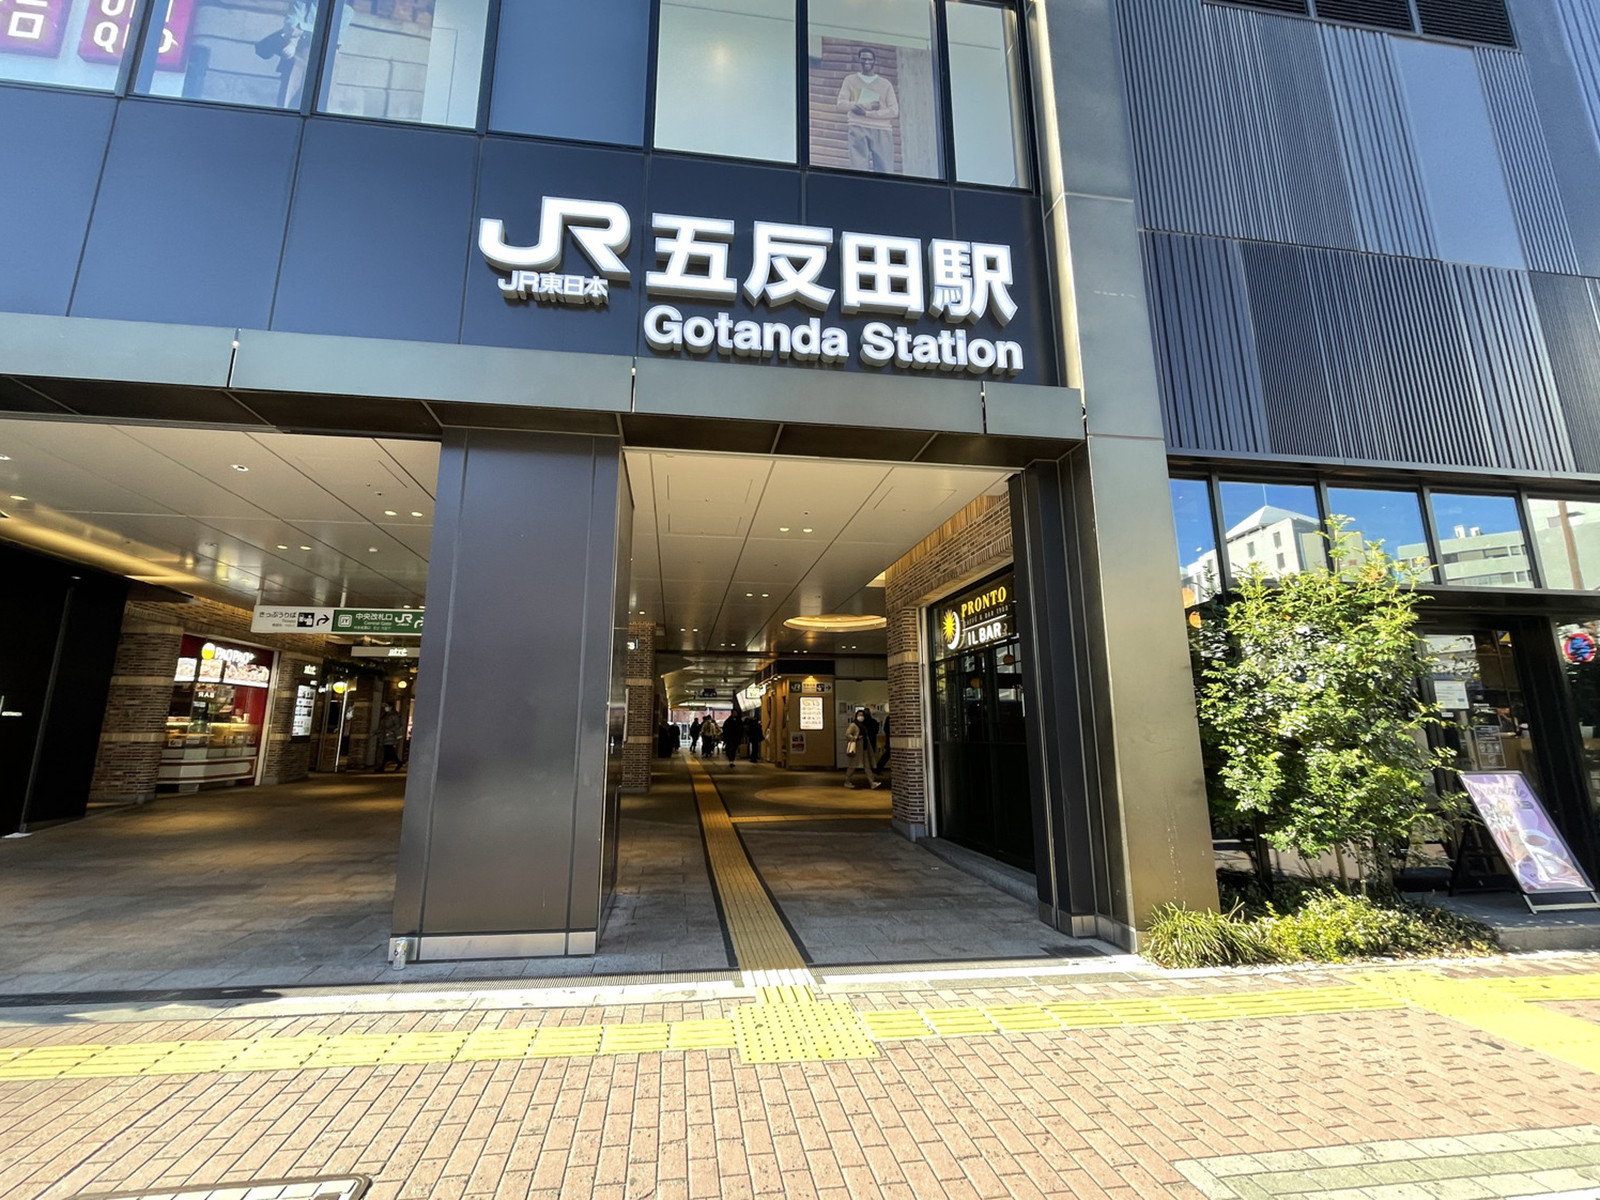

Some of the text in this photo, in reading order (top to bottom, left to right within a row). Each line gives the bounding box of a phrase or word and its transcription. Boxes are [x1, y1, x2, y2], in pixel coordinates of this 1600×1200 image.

[478, 196, 632, 277] JR
[644, 212, 1019, 325] 五反田駅
[497, 269, 610, 303] JR東日本
[643, 304, 1024, 375] Gotanda Station
[355, 613, 413, 623] 中央改札口 JR
[961, 586, 1007, 618] PRONTO
[967, 622, 1002, 646] IL BAR
